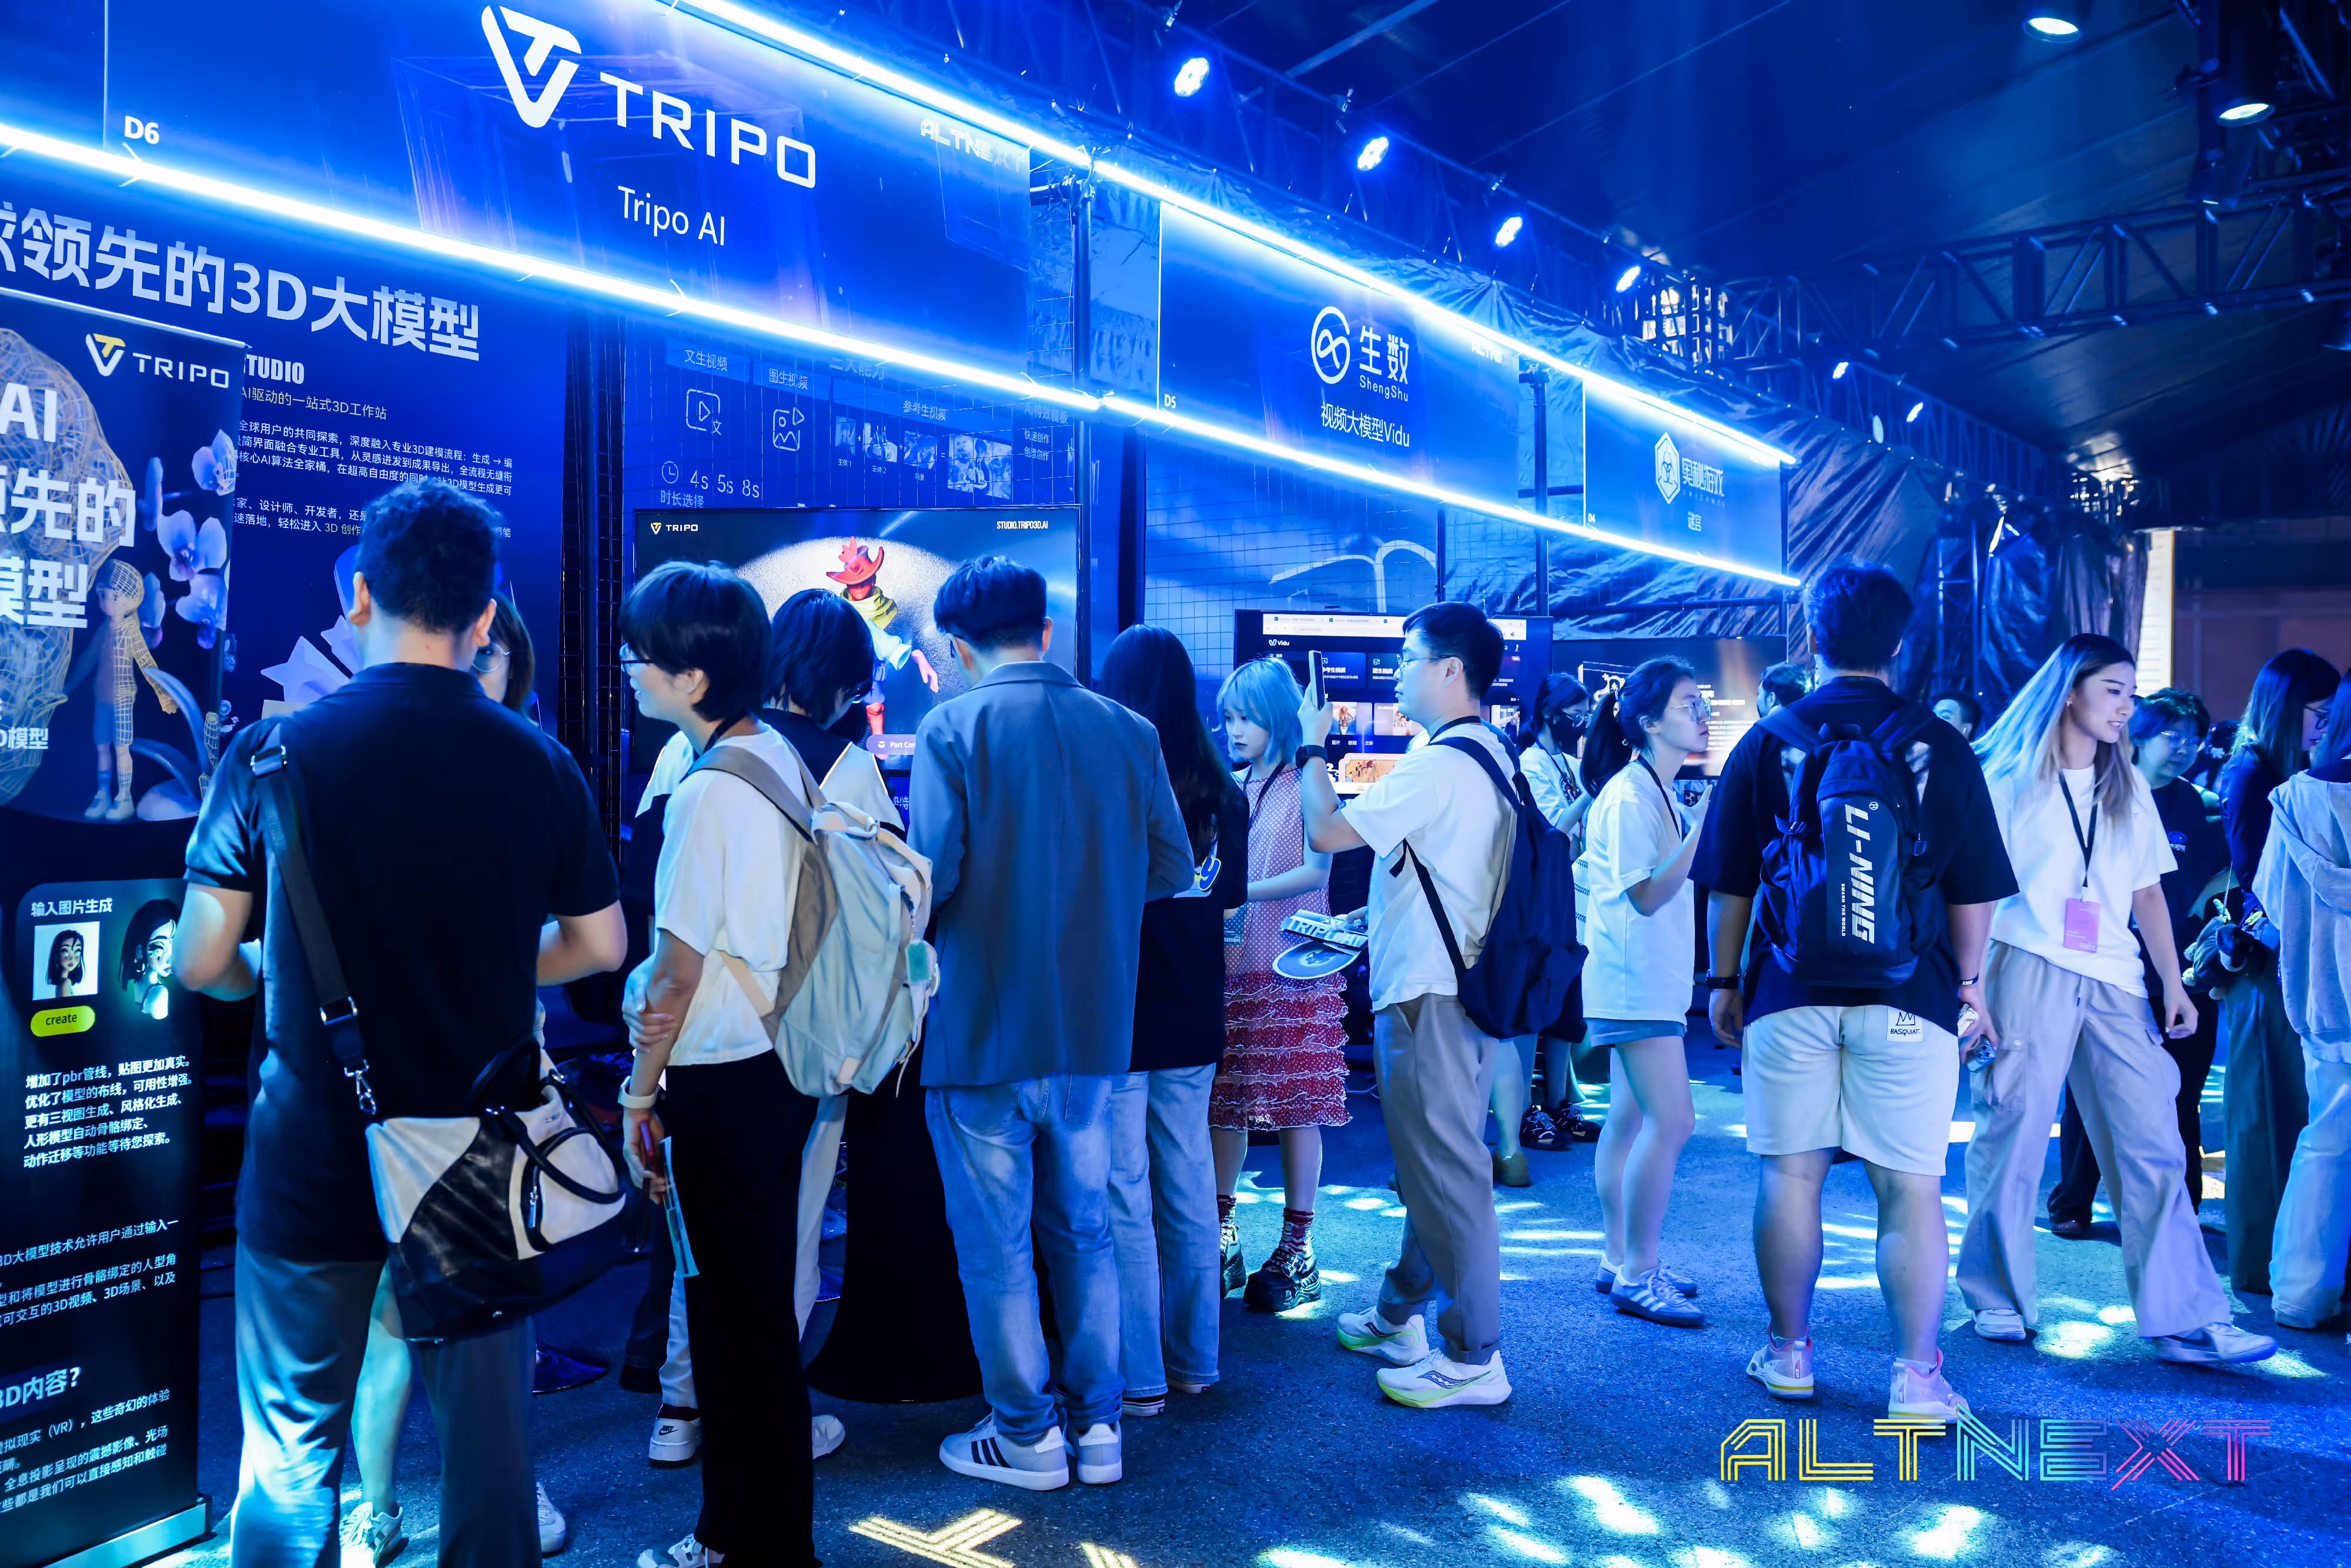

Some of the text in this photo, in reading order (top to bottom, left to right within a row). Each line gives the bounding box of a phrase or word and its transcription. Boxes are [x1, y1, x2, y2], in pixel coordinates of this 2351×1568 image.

[124, 116, 160, 145] D6
[600, 72, 815, 189] TRIPO
[618, 185, 725, 246] Tripo AI
[684, 349, 728, 372] 文生视频
[1359, 325, 1409, 385] 生数
[133, 352, 229, 389] TRIPO
[769, 368, 808, 390] 图生视频
[1164, 393, 1176, 409] D5
[1359, 375, 1409, 402] ShengShu
[1024, 430, 1049, 444] 快速创作
[1321, 401, 1410, 447] 视频大模型Vidu
[690, 471, 760, 498] 4s 5s 8s
[0, 466, 136, 547] 先的
[1588, 513, 1596, 523] D4
[232, 513, 321, 531] 速落地，轻松进入
[324, 523, 338, 533] 3D
[665, 523, 698, 532] TRIPO
[996, 520, 1048, 530] STUDIO.TRIPO3D.AI
[1845, 804, 1875, 944] LI-NING
[31, 898, 113, 917] 输入图片生成
[46, 1012, 77, 1025] create
[1890, 1028, 1920, 1037] BASQUIAT
[26, 1055, 189, 1089] 增加了pbr管线，贴图更加真实。
[25, 1073, 192, 1110] 优化了模型的布线，可用性增强。
[24, 1132, 170, 1169] 动作迁移等功能等待您探索。
[0, 1272, 176, 1328] 可交互的3D视频、3D场景、以及
[0, 1443, 168, 1514] 些都是我们可以直接感知和触碰
